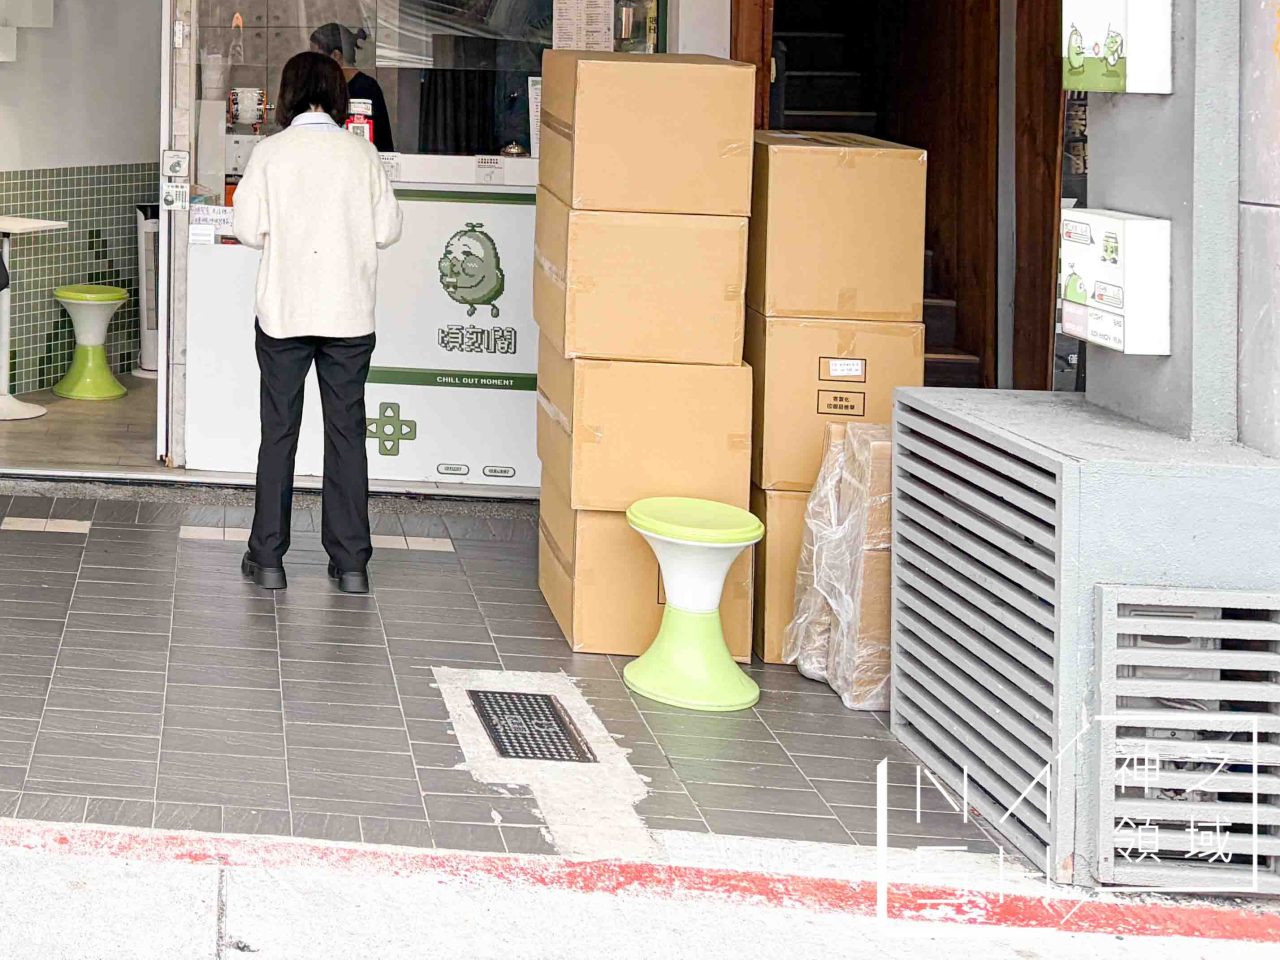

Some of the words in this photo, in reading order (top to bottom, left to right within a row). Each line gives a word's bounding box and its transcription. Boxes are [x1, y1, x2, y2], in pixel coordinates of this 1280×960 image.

[438, 325, 517, 354] 頃刻間
[436, 376, 461, 384] CHILL
[462, 377, 479, 385] OUT
[480, 378, 515, 386] MOMENT
